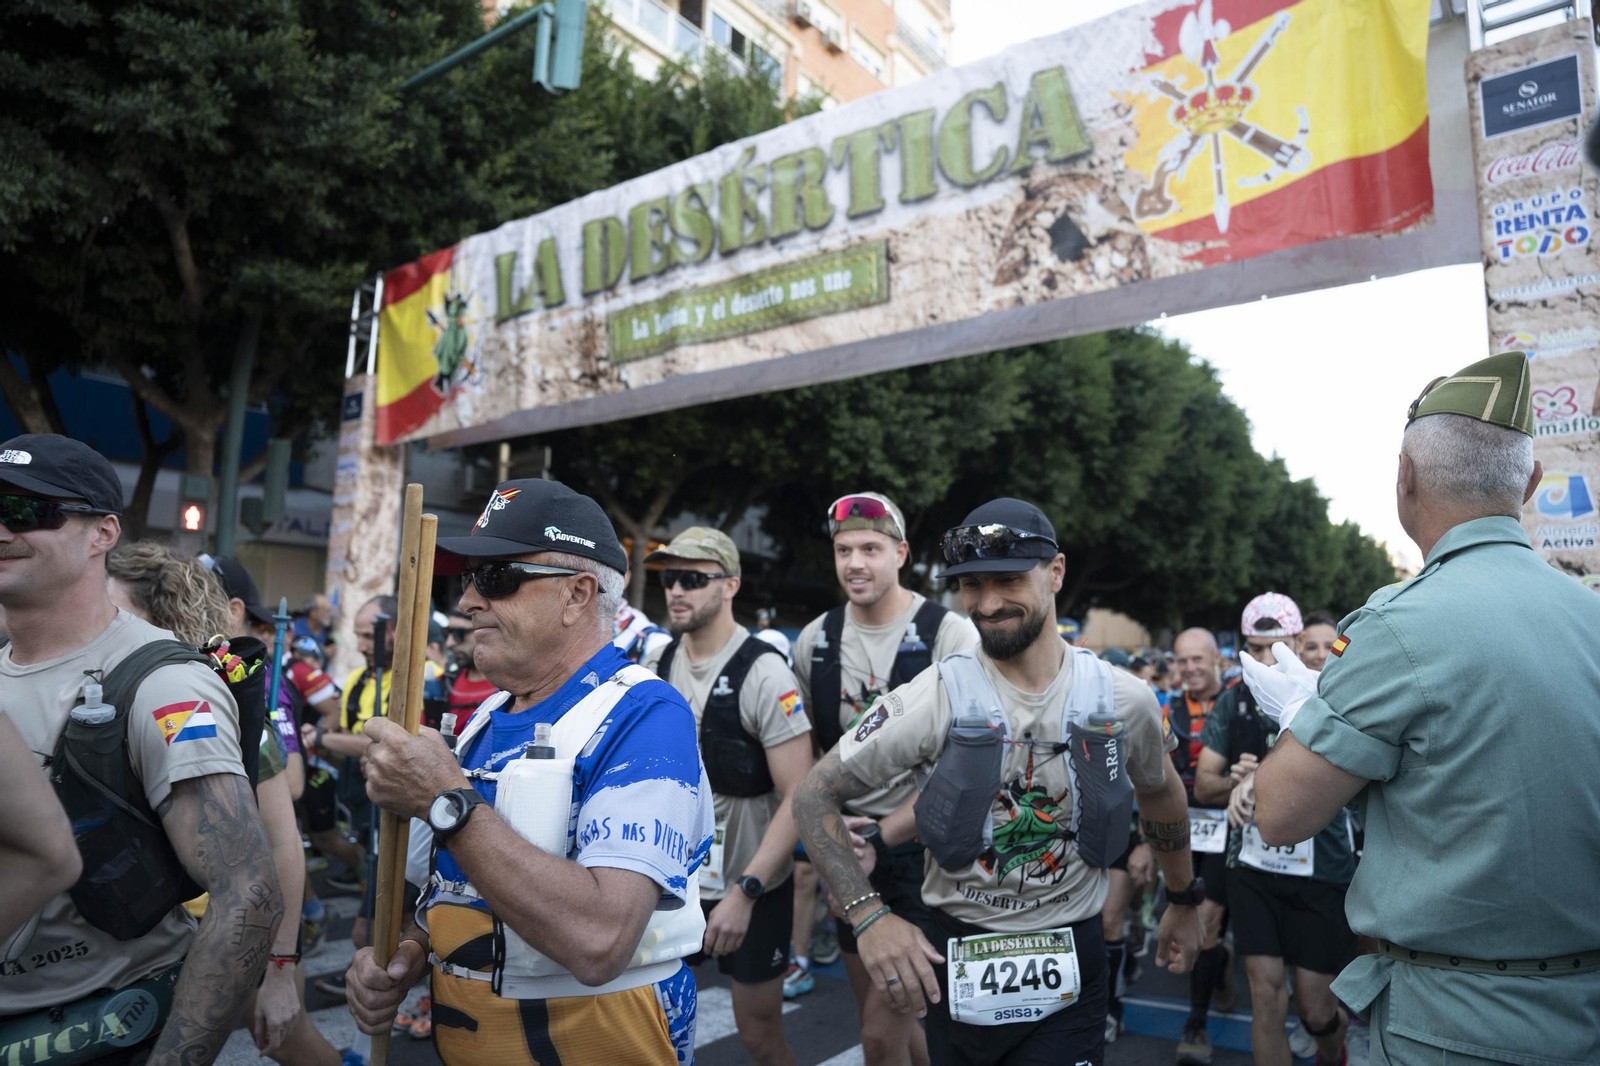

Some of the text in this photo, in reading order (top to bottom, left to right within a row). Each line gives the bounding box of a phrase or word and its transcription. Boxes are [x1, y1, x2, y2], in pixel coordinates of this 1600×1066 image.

[1502, 92, 1557, 114] SENATOR
[494, 65, 1092, 323] LA DESÉRTICA
[1495, 189, 1582, 216] GRUPO
[1496, 203, 1587, 236] RENTA
[1497, 226, 1588, 259] TODO
[632, 317, 650, 341] La
[695, 305, 706, 328] y
[712, 296, 726, 321] el
[730, 284, 784, 316] desierto
[789, 278, 817, 301] nos
[822, 269, 853, 293] une
[555, 533, 596, 550] ADVENTURE
[1542, 536, 1594, 549] Activa
[1104, 738, 1118, 768] Rab
[31, 940, 89, 969] 2025
[974, 942, 989, 955] LA
[980, 957, 1062, 996] 4246
[994, 1007, 1032, 1021] asisa
